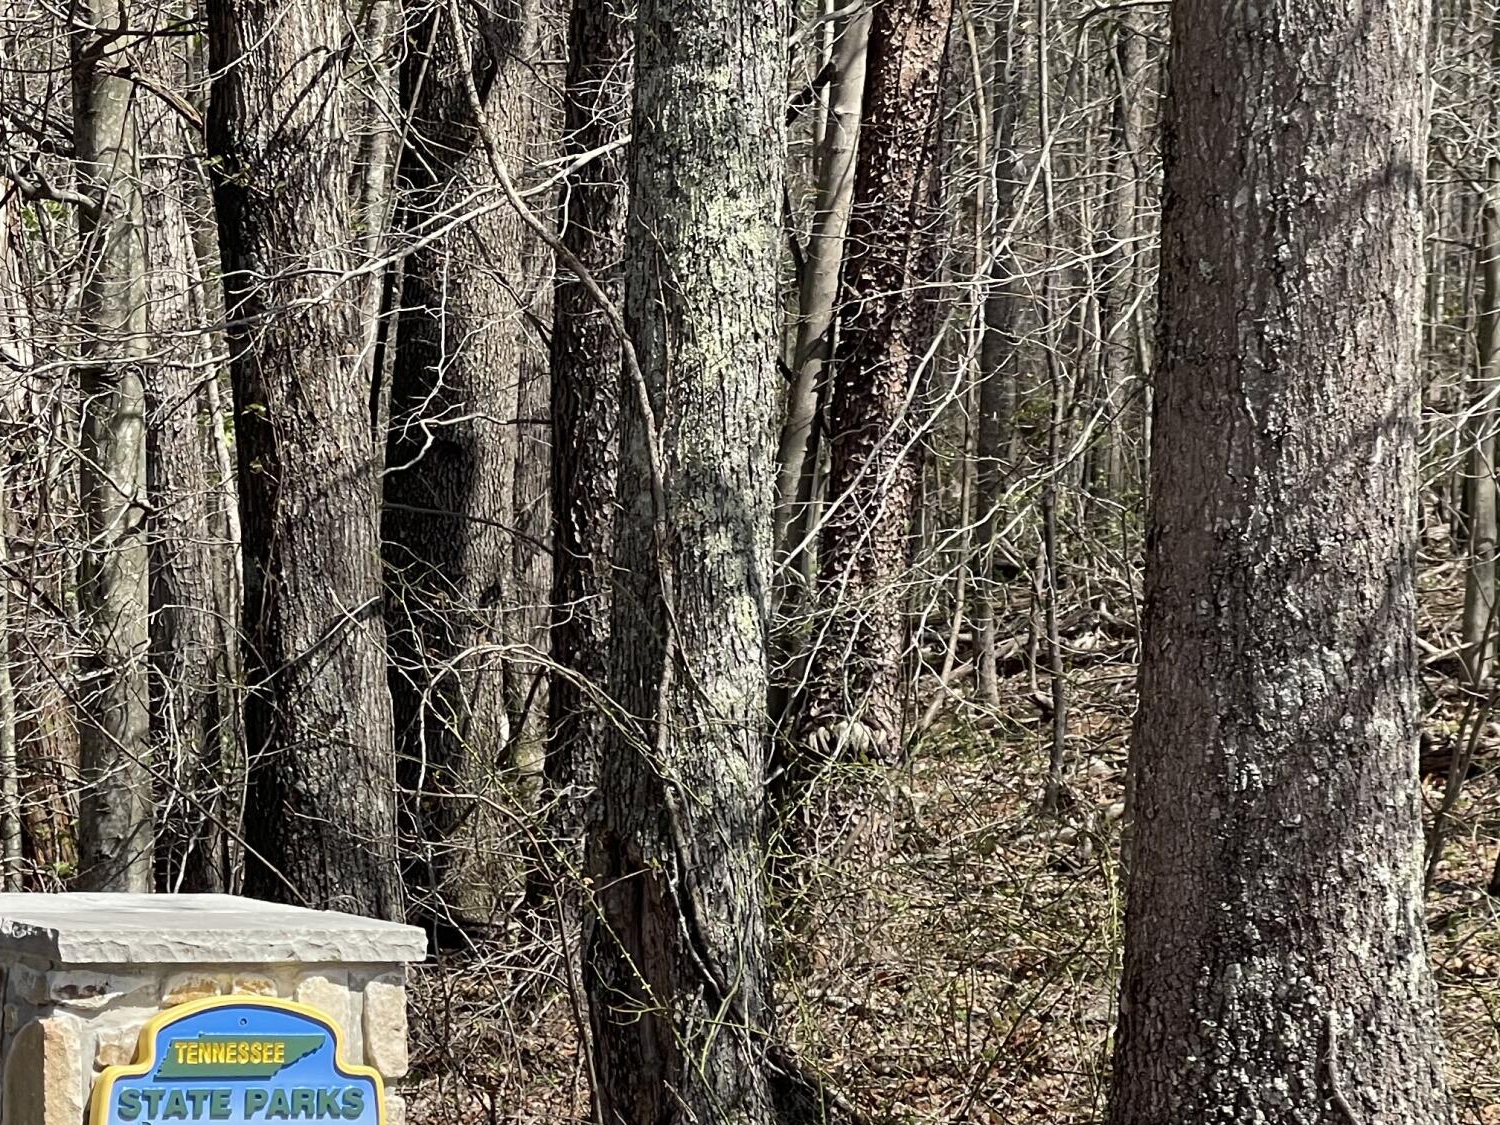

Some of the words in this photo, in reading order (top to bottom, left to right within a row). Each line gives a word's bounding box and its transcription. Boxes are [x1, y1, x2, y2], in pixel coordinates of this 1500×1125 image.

[175, 1041, 285, 1066] TENNESSEE
[117, 1088, 232, 1120] STATE
[244, 1087, 365, 1120] PARKS
